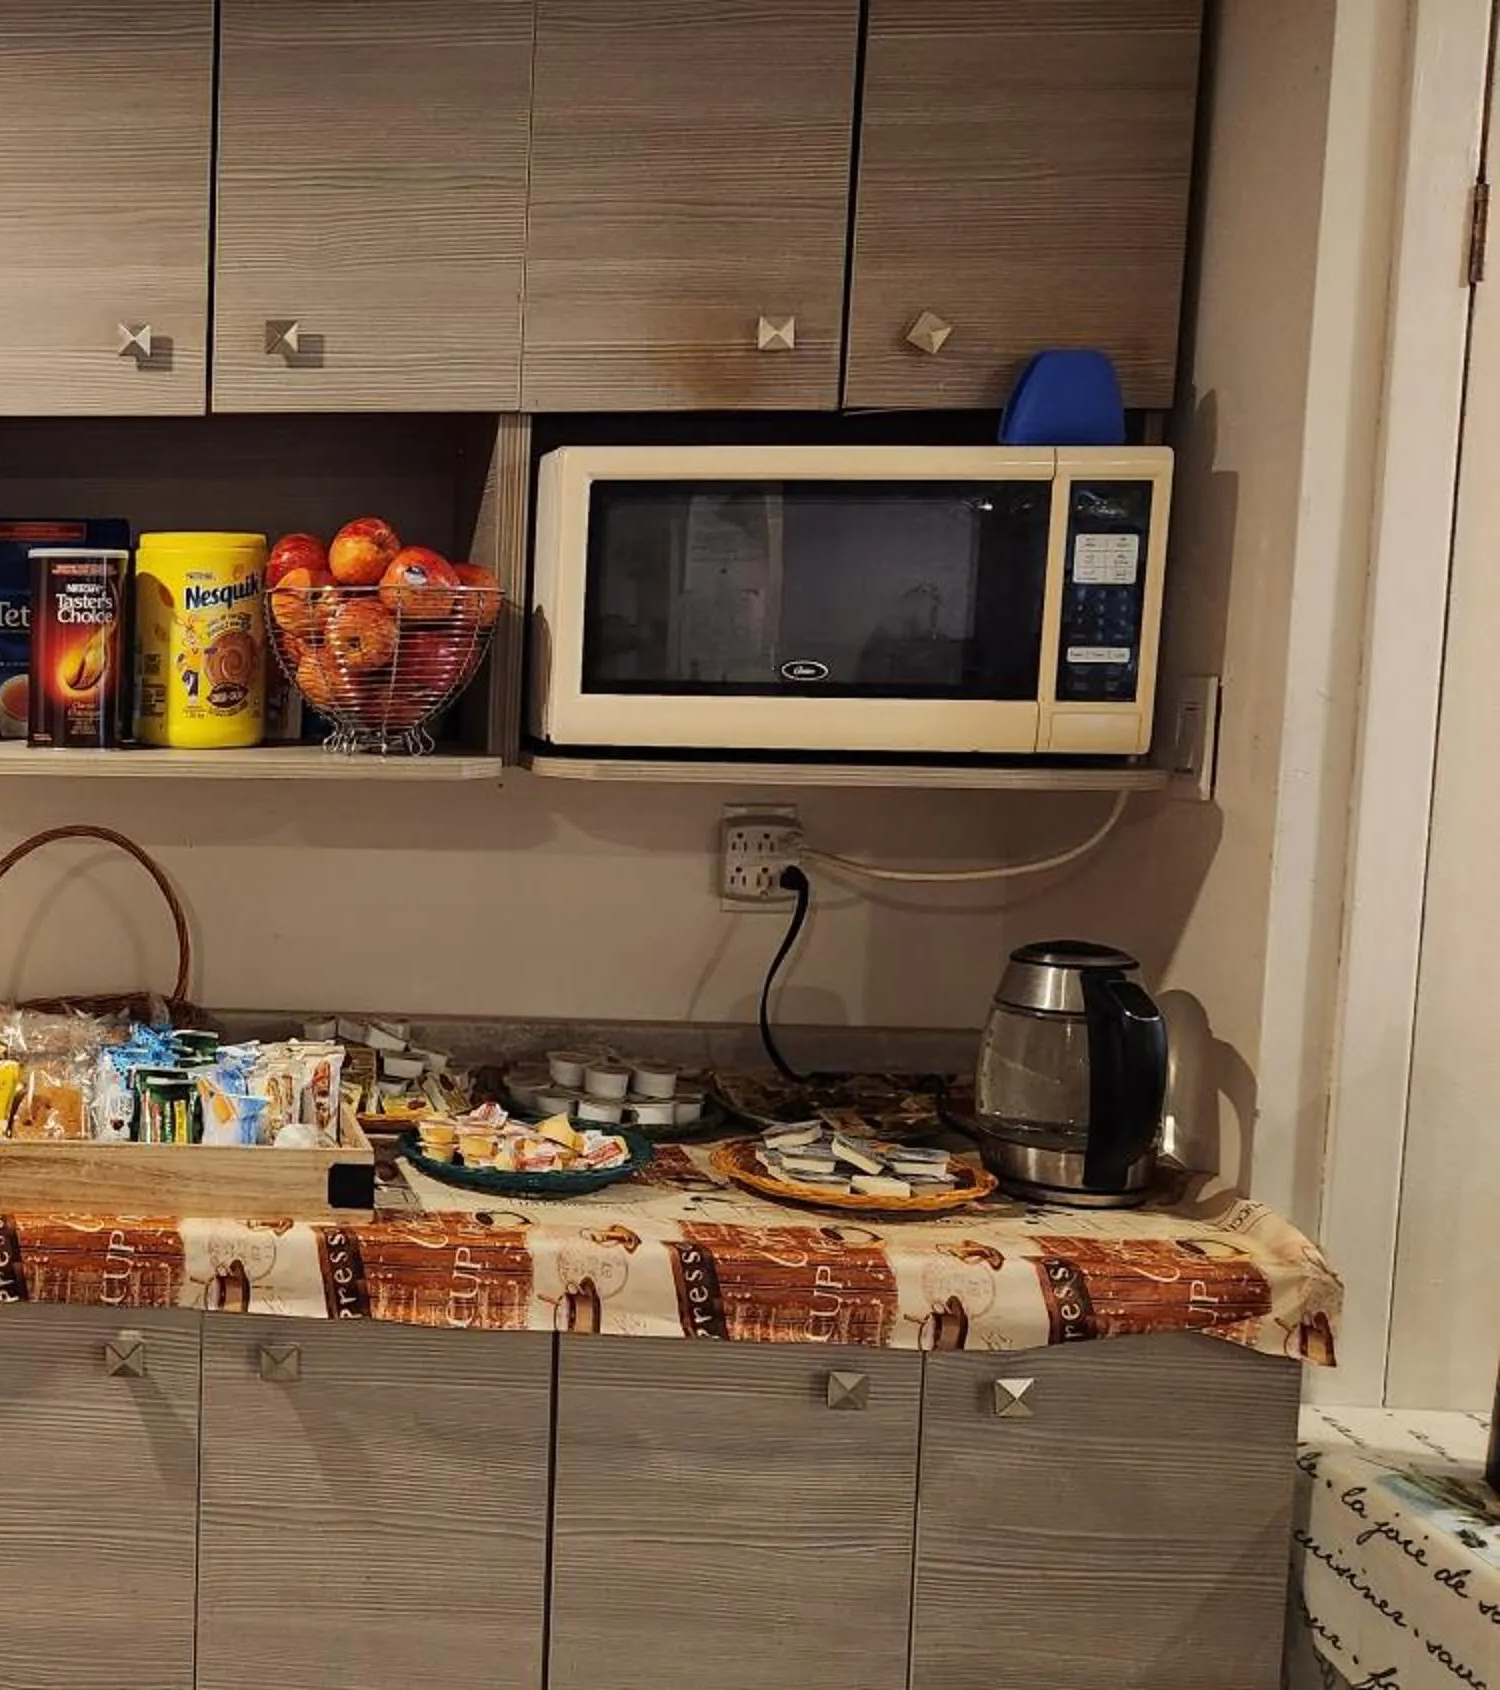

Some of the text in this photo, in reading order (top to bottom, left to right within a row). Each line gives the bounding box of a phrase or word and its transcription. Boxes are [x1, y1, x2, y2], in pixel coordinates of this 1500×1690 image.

[55, 591, 113, 609] Taster's
[57, 607, 113, 623] Choice
[185, 572, 260, 609] Nesquik
[100, 1230, 136, 1304] CUP
[445, 1247, 483, 1328] CUP
[804, 1265, 844, 1342] CUP
[1341, 1487, 1368, 1519] la
[1356, 1511, 1429, 1568] joie
[1434, 1569, 1473, 1599] de
